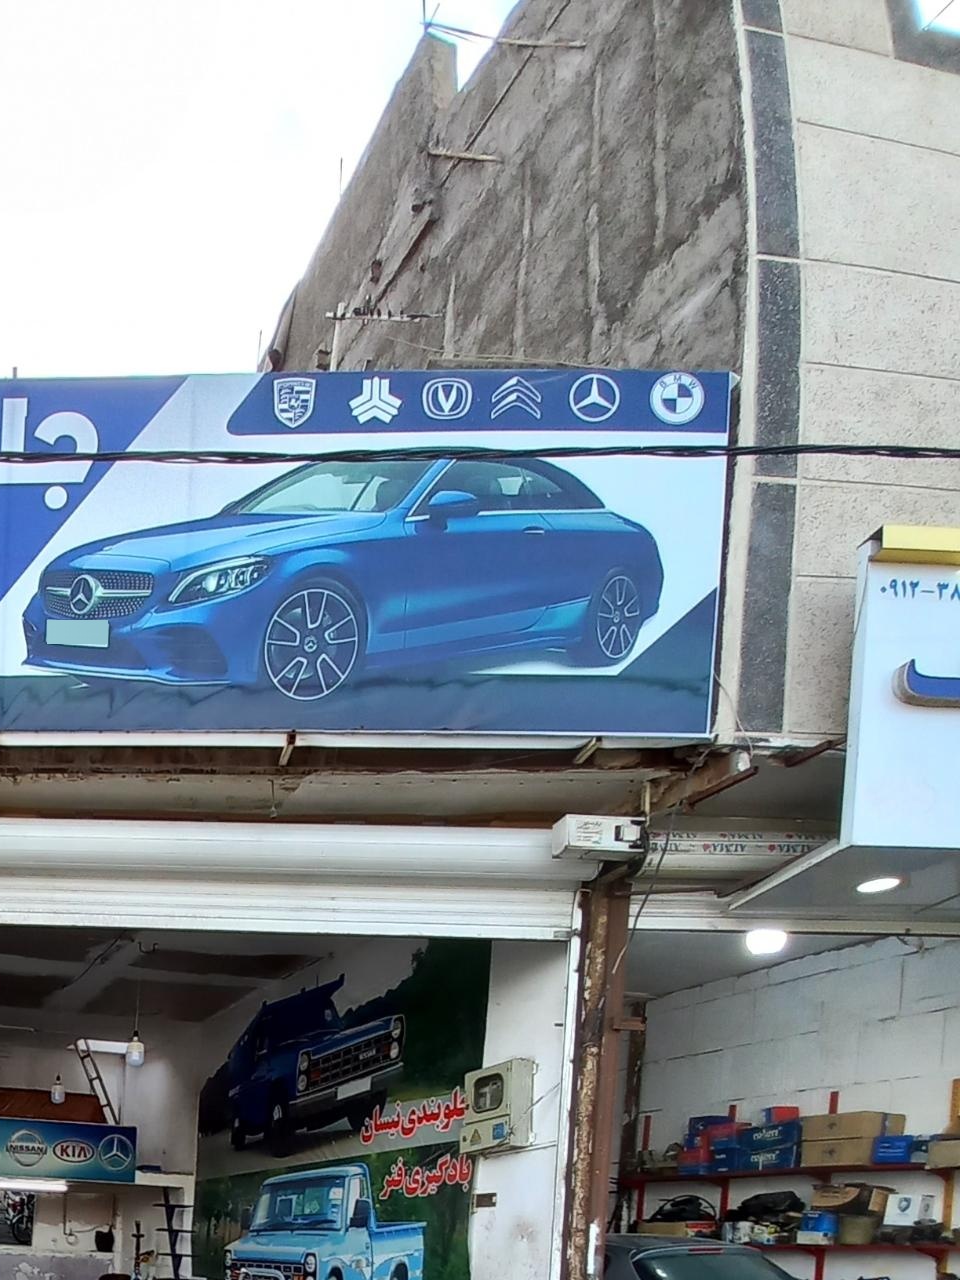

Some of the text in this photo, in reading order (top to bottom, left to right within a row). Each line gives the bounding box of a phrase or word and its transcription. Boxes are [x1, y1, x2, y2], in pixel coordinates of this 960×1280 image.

[360, 1100, 402, 1146] نیسان
[9, 1144, 44, 1154] NISSAN
[59, 1145, 89, 1159] KIA
